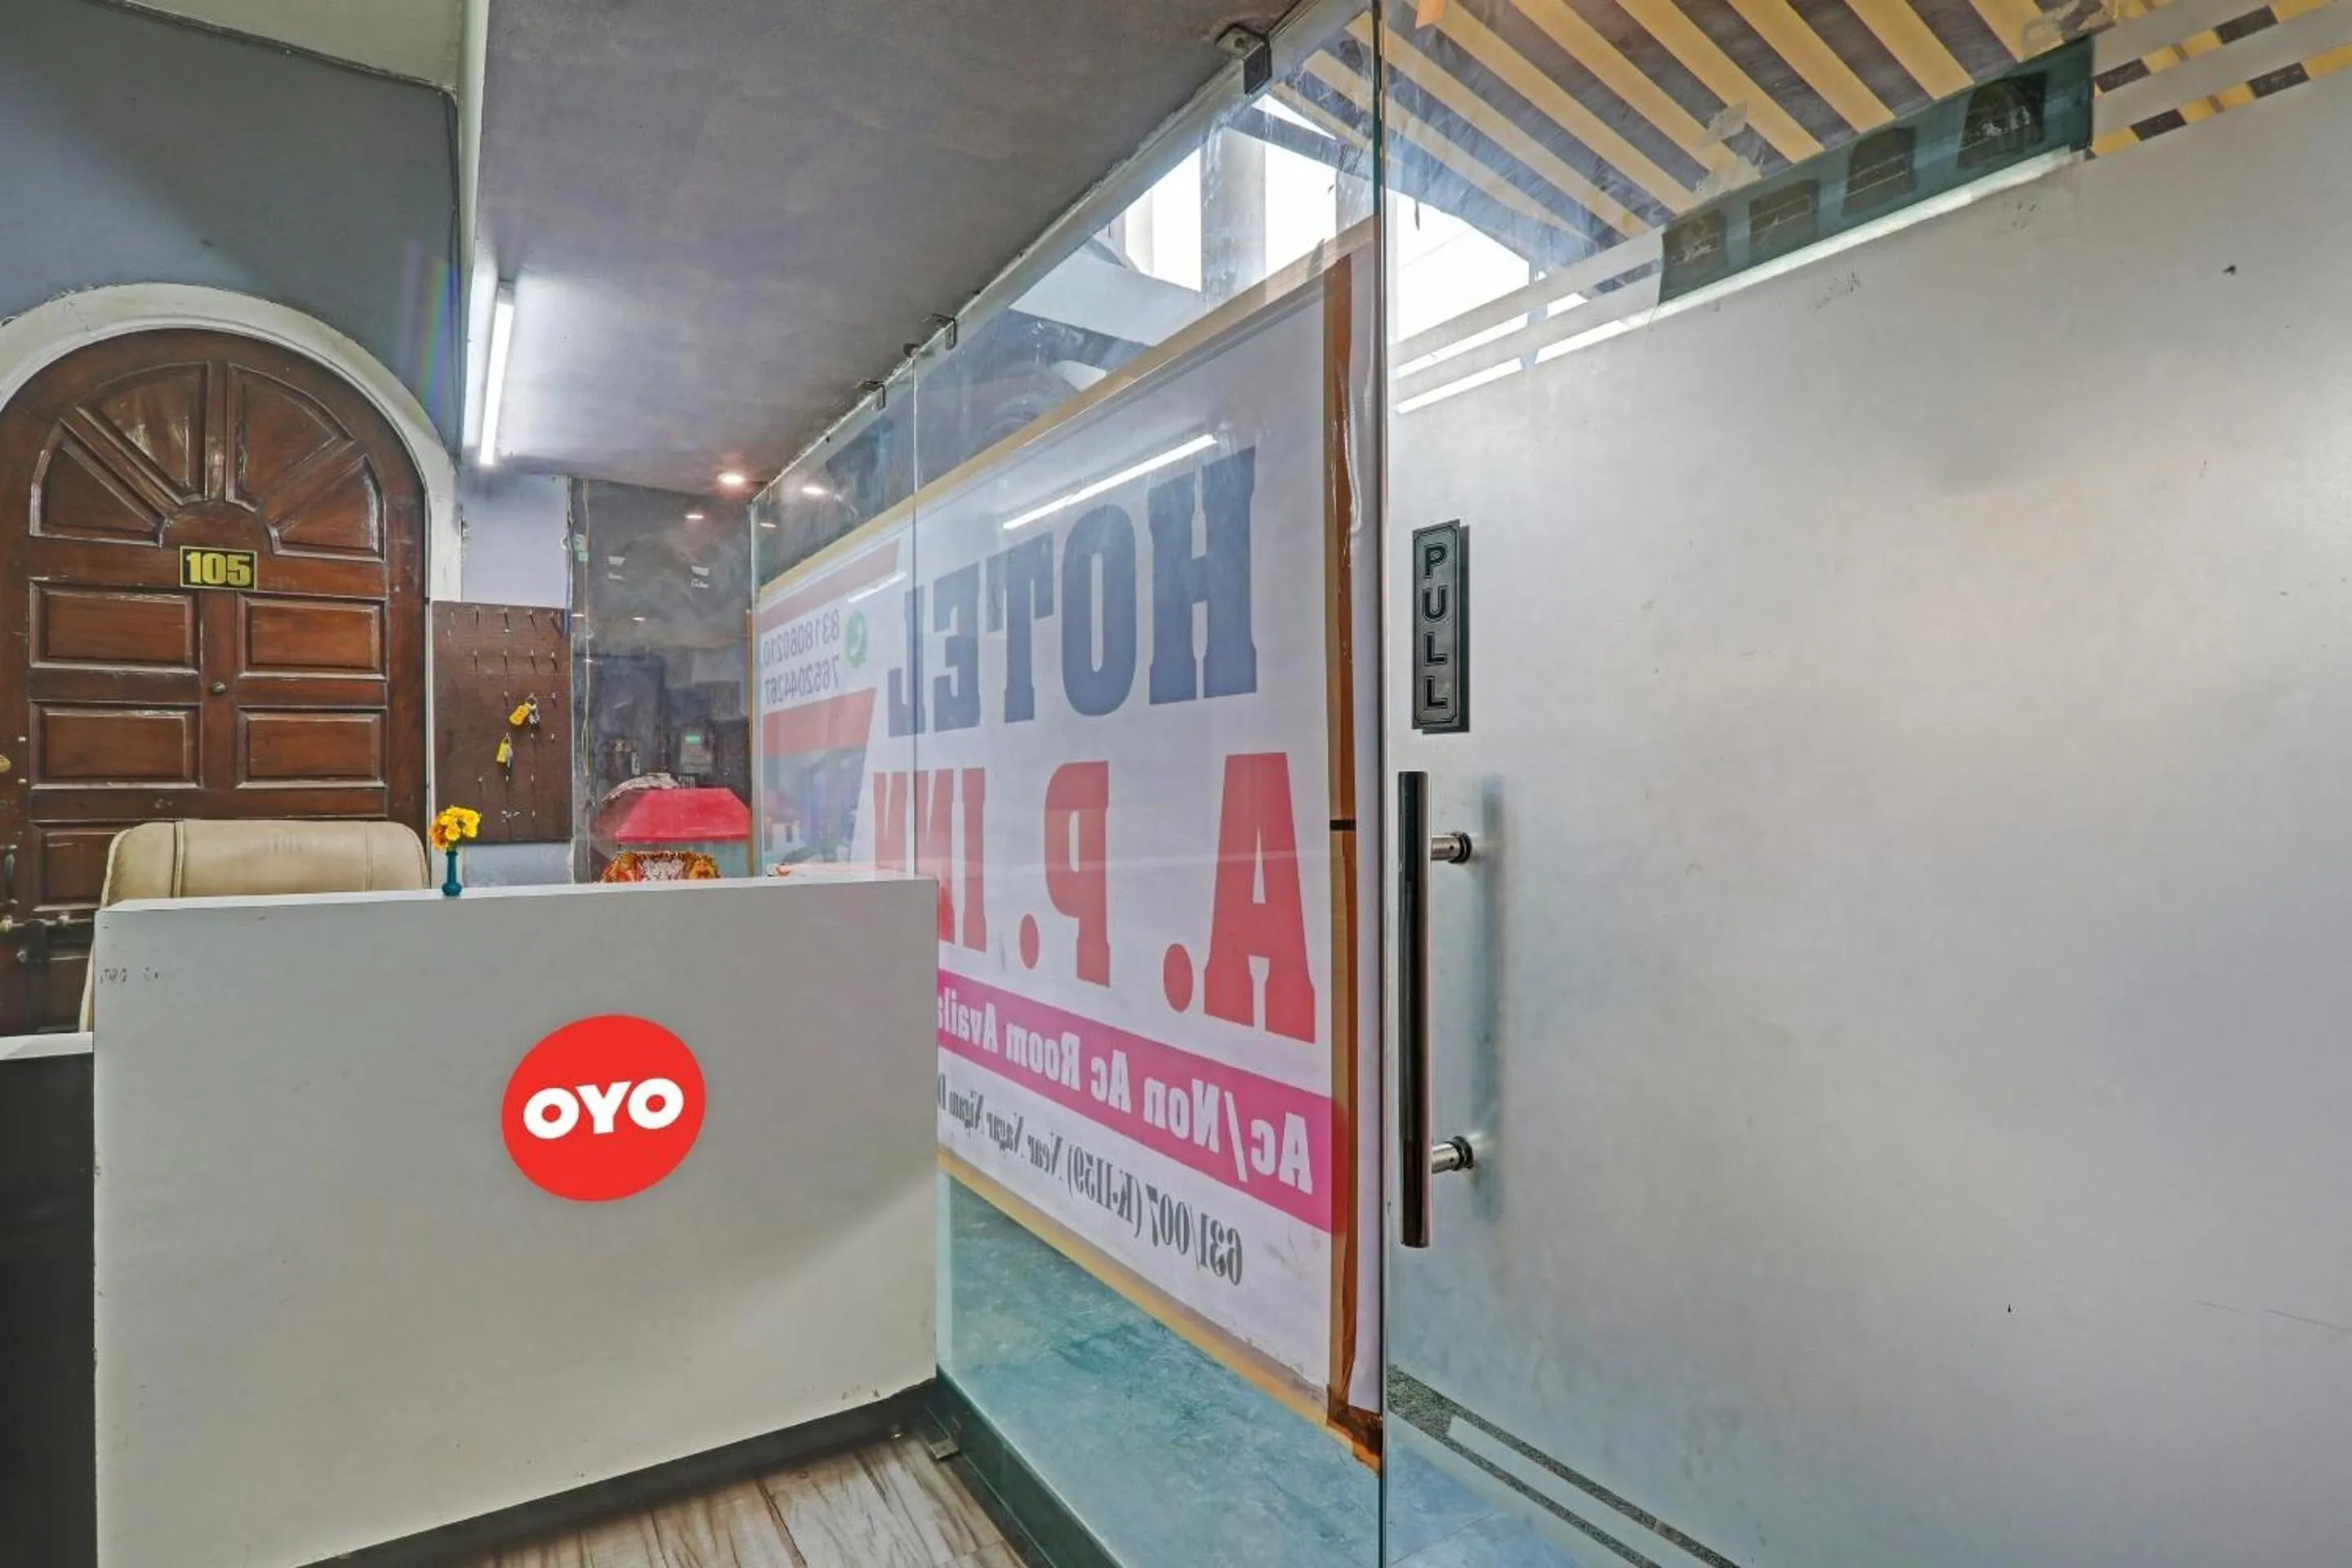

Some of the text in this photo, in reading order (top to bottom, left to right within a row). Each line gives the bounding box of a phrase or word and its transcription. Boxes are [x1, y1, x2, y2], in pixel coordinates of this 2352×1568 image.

[186, 551, 251, 586] 105
[1422, 542, 1448, 710] PULL
[523, 1077, 684, 1139] OYO
